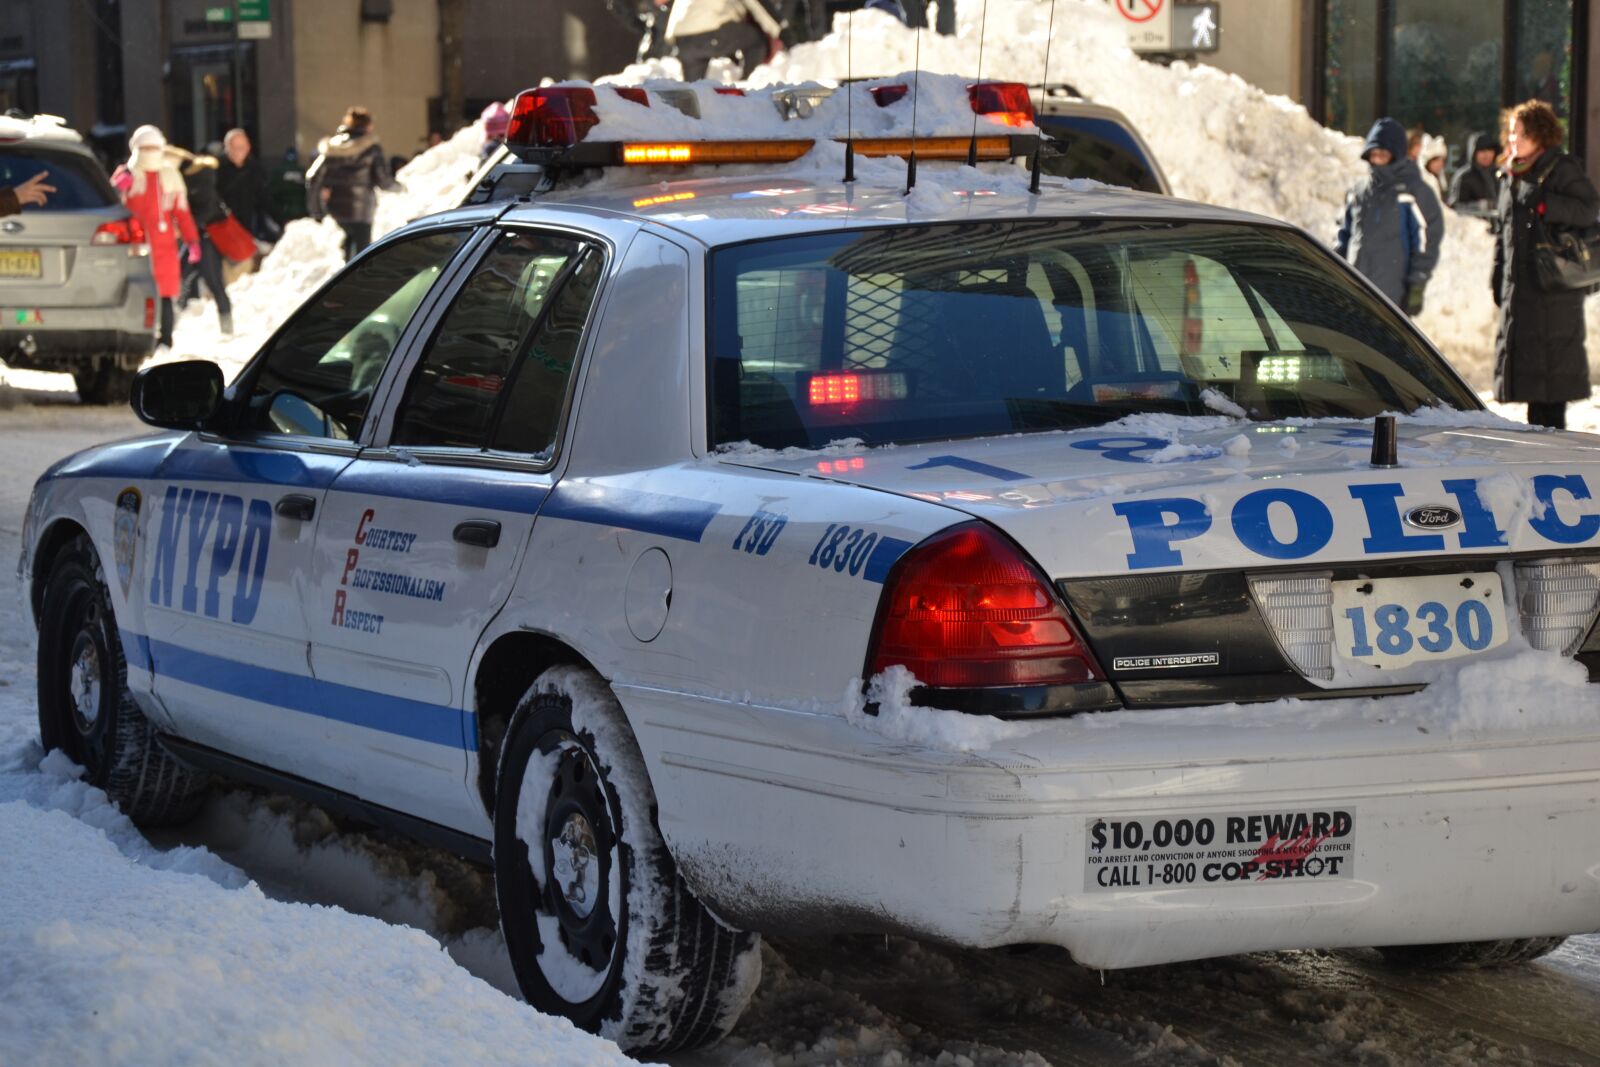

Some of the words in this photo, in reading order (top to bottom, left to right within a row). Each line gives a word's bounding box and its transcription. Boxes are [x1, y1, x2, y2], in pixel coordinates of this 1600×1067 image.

[355, 509, 417, 552] COURTESY
[1112, 474, 1600, 570] POLIC
[1419, 509, 1449, 524] Ford
[150, 486, 273, 625] NYPD
[808, 523, 878, 577] 1830
[341, 548, 446, 602] PROFESSIONALISM
[331, 589, 384, 635] RESPECT
[1346, 599, 1494, 657] 1830
[1117, 659, 1150, 667] POLICE
[1153, 655, 1216, 665] INTERCEPTOR
[1088, 856, 1102, 864] FOR
[1105, 855, 1131, 863] ARREST
[1133, 854, 1149, 862] AND
[1151, 852, 1194, 861] CONVICTION
[1196, 851, 1205, 859] OF
[1207, 849, 1236, 858] ANYONE
[1324, 843, 1351, 852] OFFICER
[1091, 818, 1215, 853] $10,000
[1226, 811, 1353, 844] REWARD
[1097, 865, 1141, 887] CALL
[1147, 863, 1196, 885] 1-800
[1202, 855, 1344, 882] COP-SHOT
